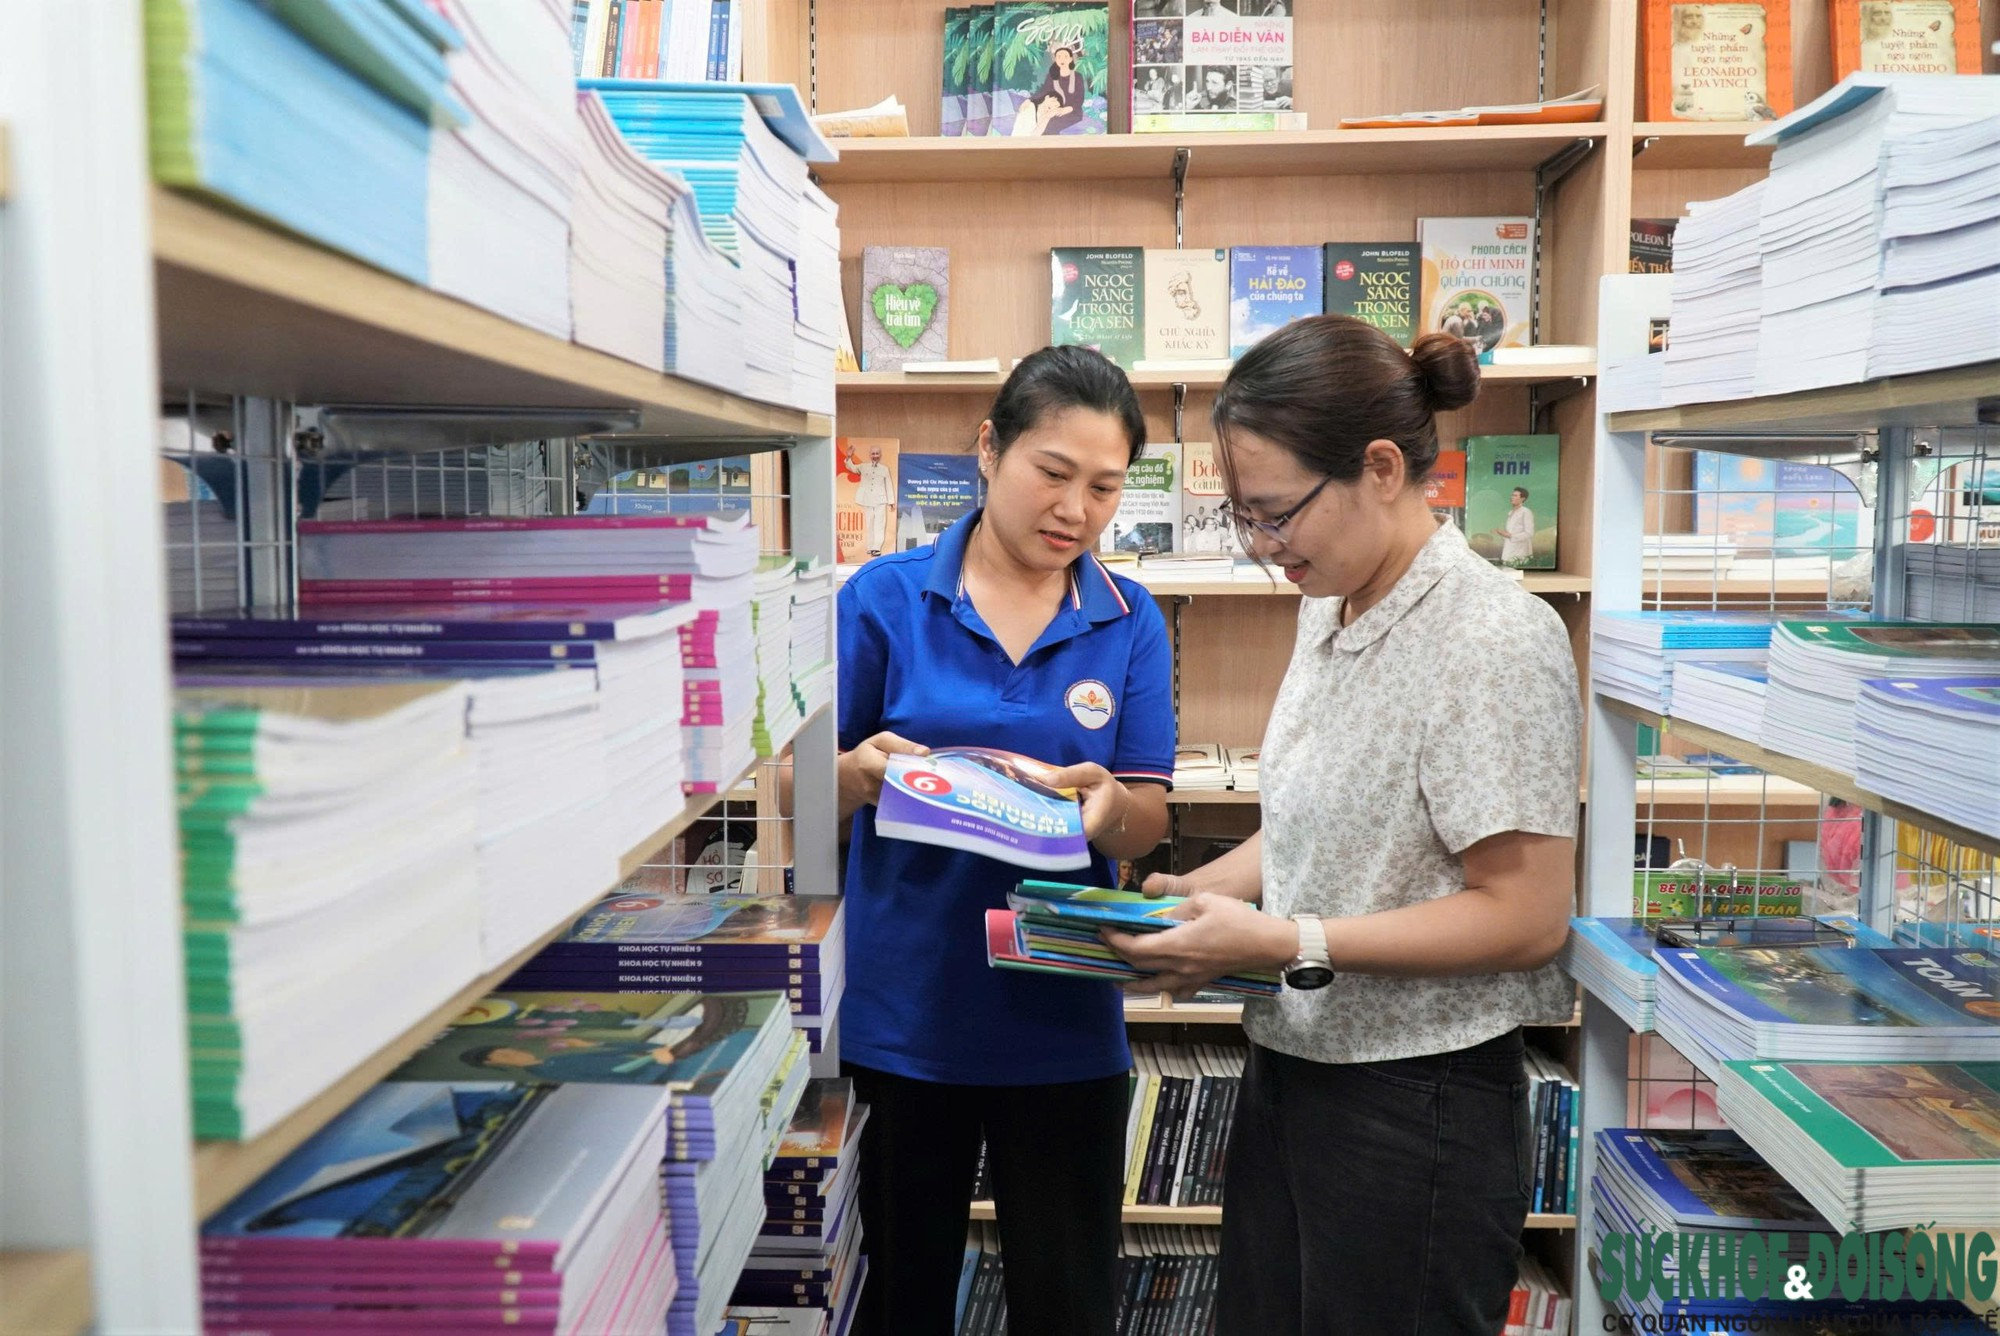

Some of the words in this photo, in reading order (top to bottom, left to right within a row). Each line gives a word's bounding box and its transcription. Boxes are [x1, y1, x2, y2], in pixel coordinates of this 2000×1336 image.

[1191, 28, 1215, 43] BÀI
[1219, 26, 1252, 43] DIỄN
[1256, 29, 1285, 43] VĂN
[1683, 66, 1757, 77] LEONARDO
[1874, 63, 1948, 73] LEONARDO
[1693, 78, 1711, 88] DA
[1713, 78, 1748, 88] VINCI
[1471, 245, 1501, 255] PHONG
[1503, 243, 1527, 255] CÁCH
[1440, 254, 1460, 270] HỒ
[1462, 256, 1486, 270] CHÍ
[1489, 259, 1525, 270] MINH
[1278, 264, 1289, 276] về
[1083, 273, 1135, 289] NGỌC
[1249, 274, 1273, 290] HẢI
[1275, 274, 1307, 290] ĐẢO
[1359, 271, 1411, 287] NGỌC
[1480, 273, 1526, 289] CHÚNG
[885, 293, 908, 311] Hiểu
[908, 295, 921, 311] về
[1250, 291, 1265, 301] của
[1266, 290, 1293, 303] chúng
[1294, 291, 1305, 301] ta
[1077, 302, 1135, 315] TRONG
[1353, 301, 1410, 314] TRONG
[886, 311, 904, 327] trái
[904, 312, 921, 327] tim
[1106, 315, 1135, 329] SEN
[1381, 315, 1410, 328] SEN
[1184, 325, 1216, 337] NGHĨA
[1140, 463, 1154, 473] câu
[1493, 461, 1531, 475] ANH
[1135, 474, 1165, 487] nghiệm
[1757, 902, 1799, 915] TOÁN
[618, 945, 641, 953] KHOA
[641, 945, 659, 954] HỌC
[660, 945, 671, 954] TỰ
[671, 944, 696, 953] NHIÊN
[696, 945, 702, 953] 9
[642, 960, 660, 968] HỌC
[661, 960, 672, 968] TỰ
[672, 959, 697, 967] NHIÊN
[642, 975, 660, 983] HỌC
[661, 975, 672, 983] TỰ
[672, 974, 697, 982] NHIÊN
[1903, 957, 1994, 998] TOÁN
